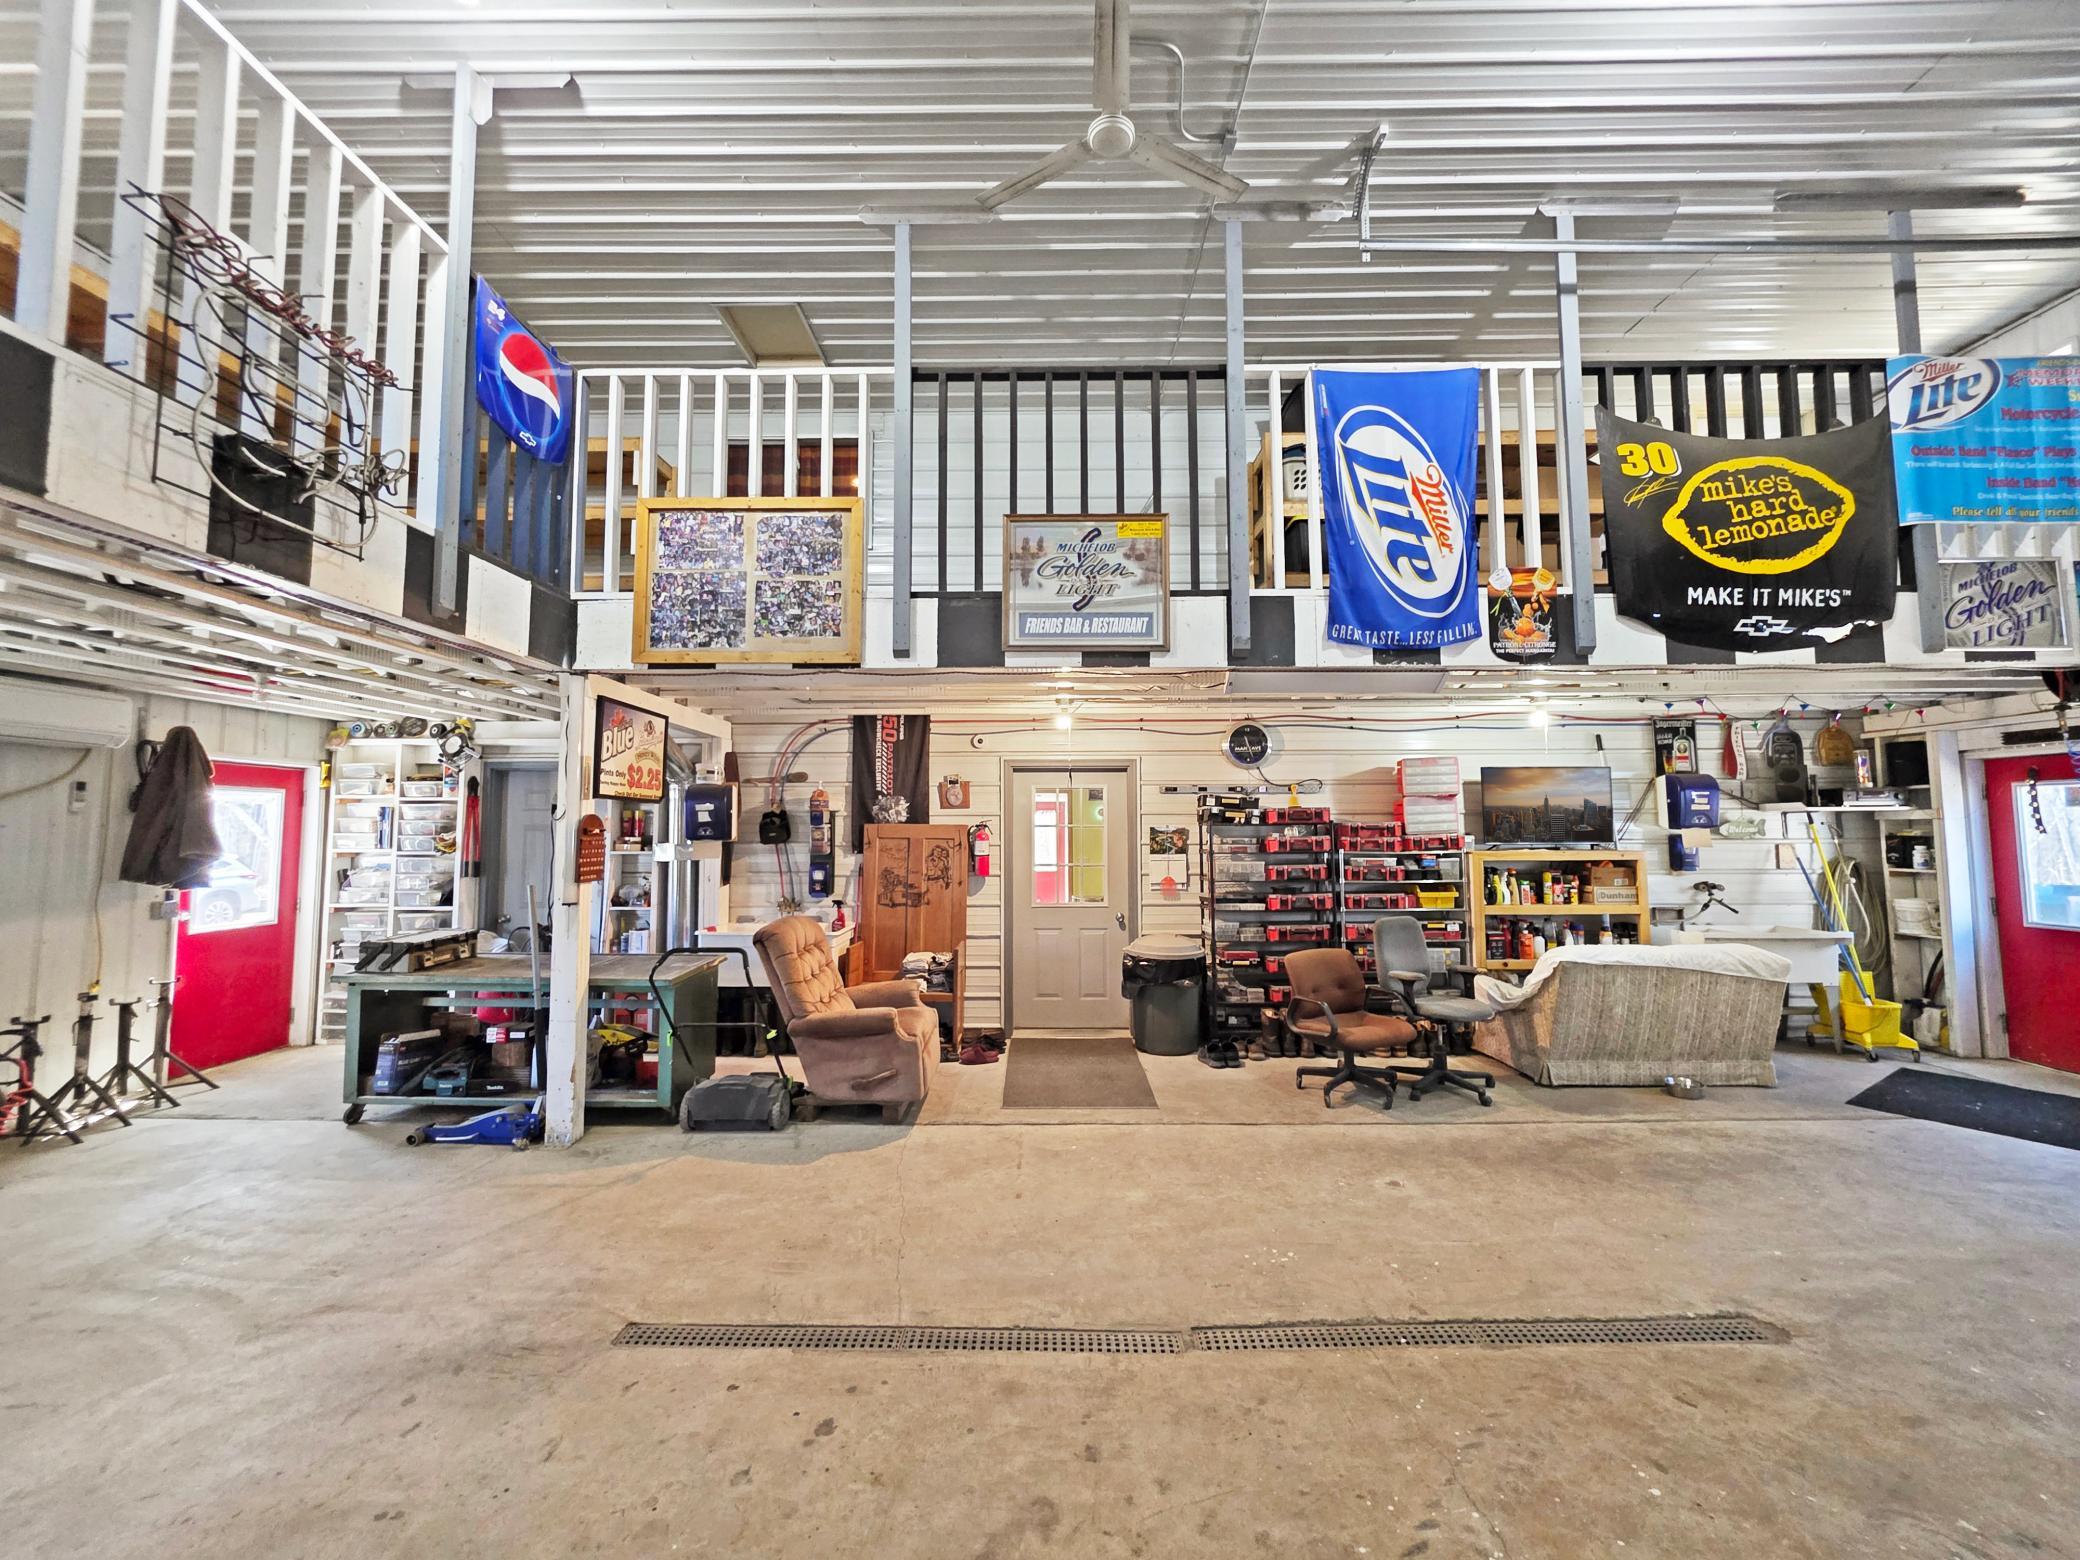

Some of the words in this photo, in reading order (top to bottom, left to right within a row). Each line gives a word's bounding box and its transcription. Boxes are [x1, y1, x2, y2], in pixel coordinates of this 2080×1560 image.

[1914, 362, 1964, 382] Miller
[1904, 373, 1982, 427] Lite
[1616, 442, 1682, 478] 30
[1700, 474, 1793, 502] mike's
[1338, 441, 1438, 583] Lite
[1410, 464, 1455, 557] Miller
[1726, 488, 1808, 523] hard
[1057, 543, 1116, 553] MICHELOB
[1037, 553, 1135, 578] Golden
[1958, 562, 2018, 593] MICHELOB
[1056, 583, 1118, 596] LIGHT
[1687, 587, 1744, 606] MAKE
[1753, 588, 1772, 606] IT
[1945, 579, 2057, 629] Golden
[1025, 617, 1062, 634] FRIENDS
[1063, 617, 1083, 634] BAR
[1083, 620, 1090, 634] &
[1091, 617, 1149, 634] RESTAURANT
[1973, 602, 2052, 646] LIGHT
[600, 725, 635, 762] Blue
[627, 763, 662, 791] $2.25
